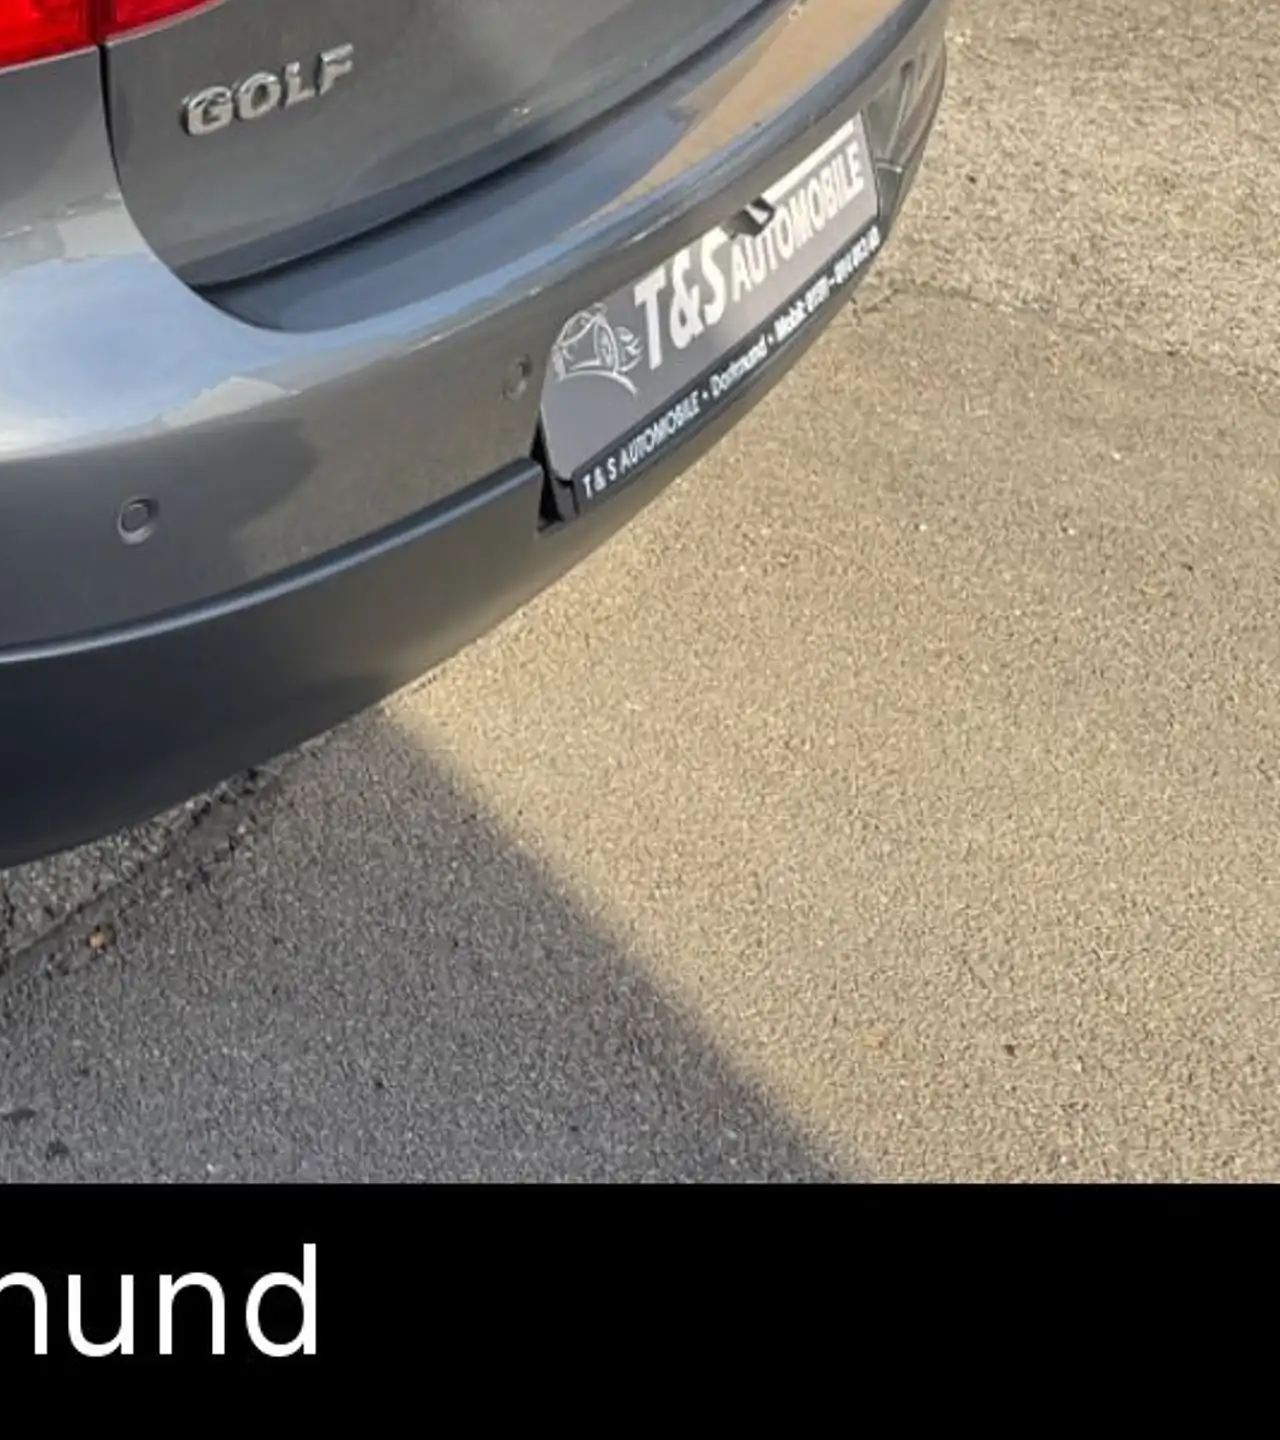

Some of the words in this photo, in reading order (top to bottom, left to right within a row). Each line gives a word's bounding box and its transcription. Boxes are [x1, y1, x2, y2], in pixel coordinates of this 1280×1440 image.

[180, 42, 354, 137] GOLF
[634, 226, 730, 371] T&S
[730, 140, 865, 302] AUTOMOBILE
[619, 389, 700, 475] AUTOMOBILE
